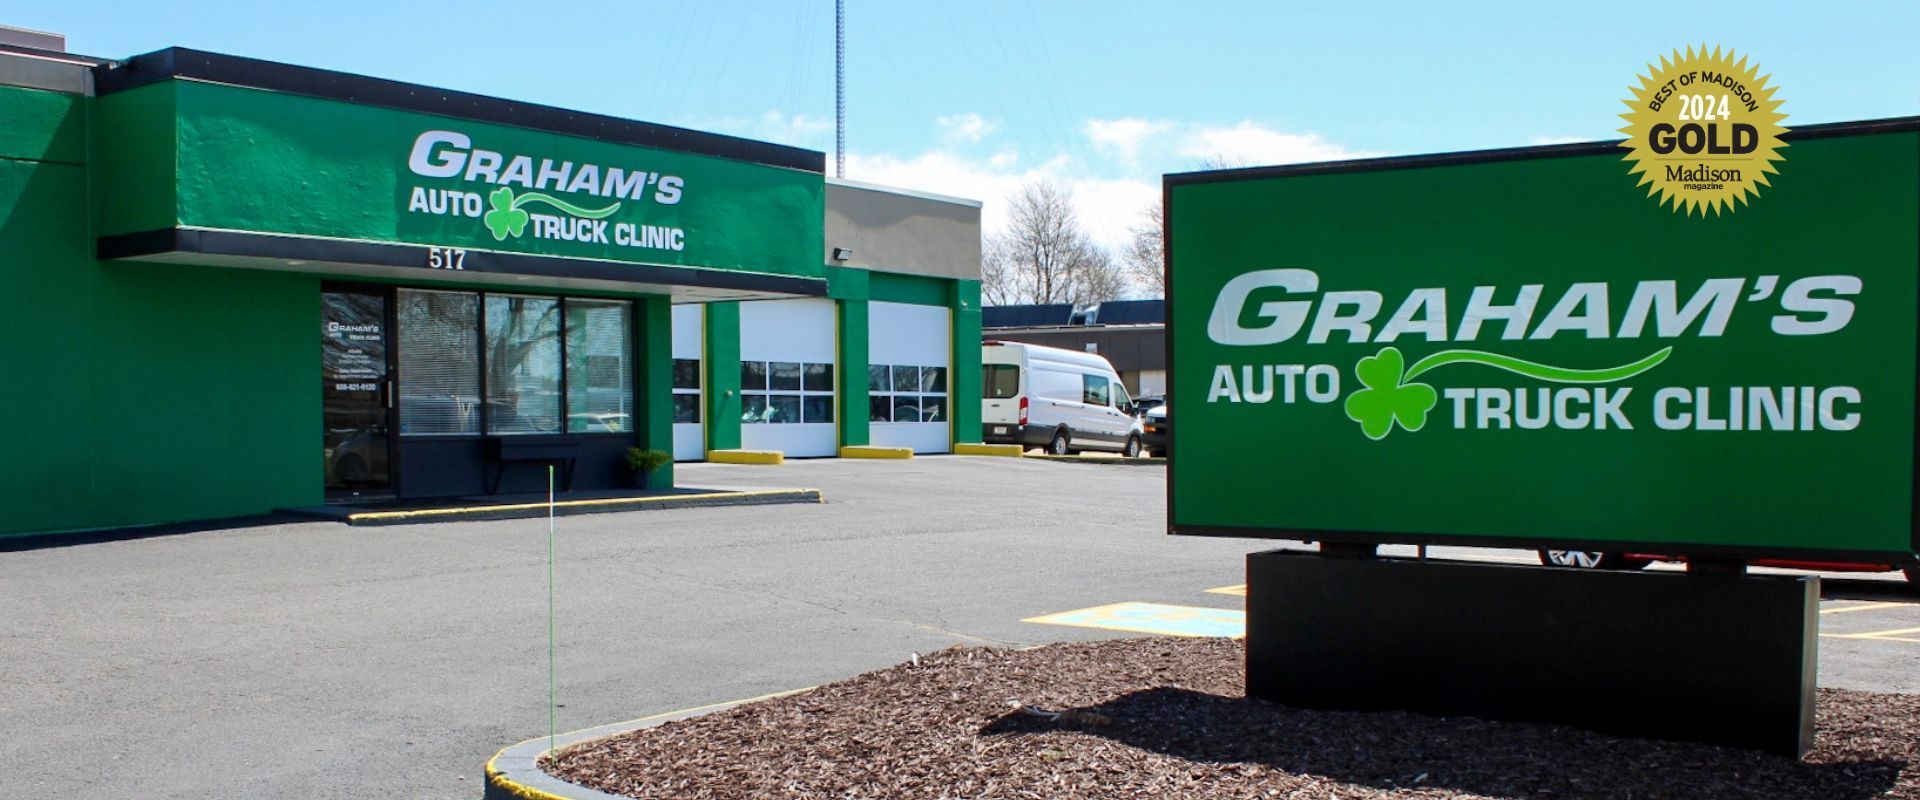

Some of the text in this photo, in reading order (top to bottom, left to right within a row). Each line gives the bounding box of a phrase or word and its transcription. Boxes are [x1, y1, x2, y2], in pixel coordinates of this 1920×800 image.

[408, 130, 684, 205] GRAHAM'S
[408, 186, 482, 218] AUTO
[530, 213, 685, 251] TRUCK CLINIC
[429, 248, 467, 270] 517
[1207, 268, 1863, 346] GRAHAM'S
[328, 321, 379, 333] GRAHAM'S
[1207, 364, 1341, 404] AUTO
[1444, 386, 1862, 431] TRUCK CLINIC
